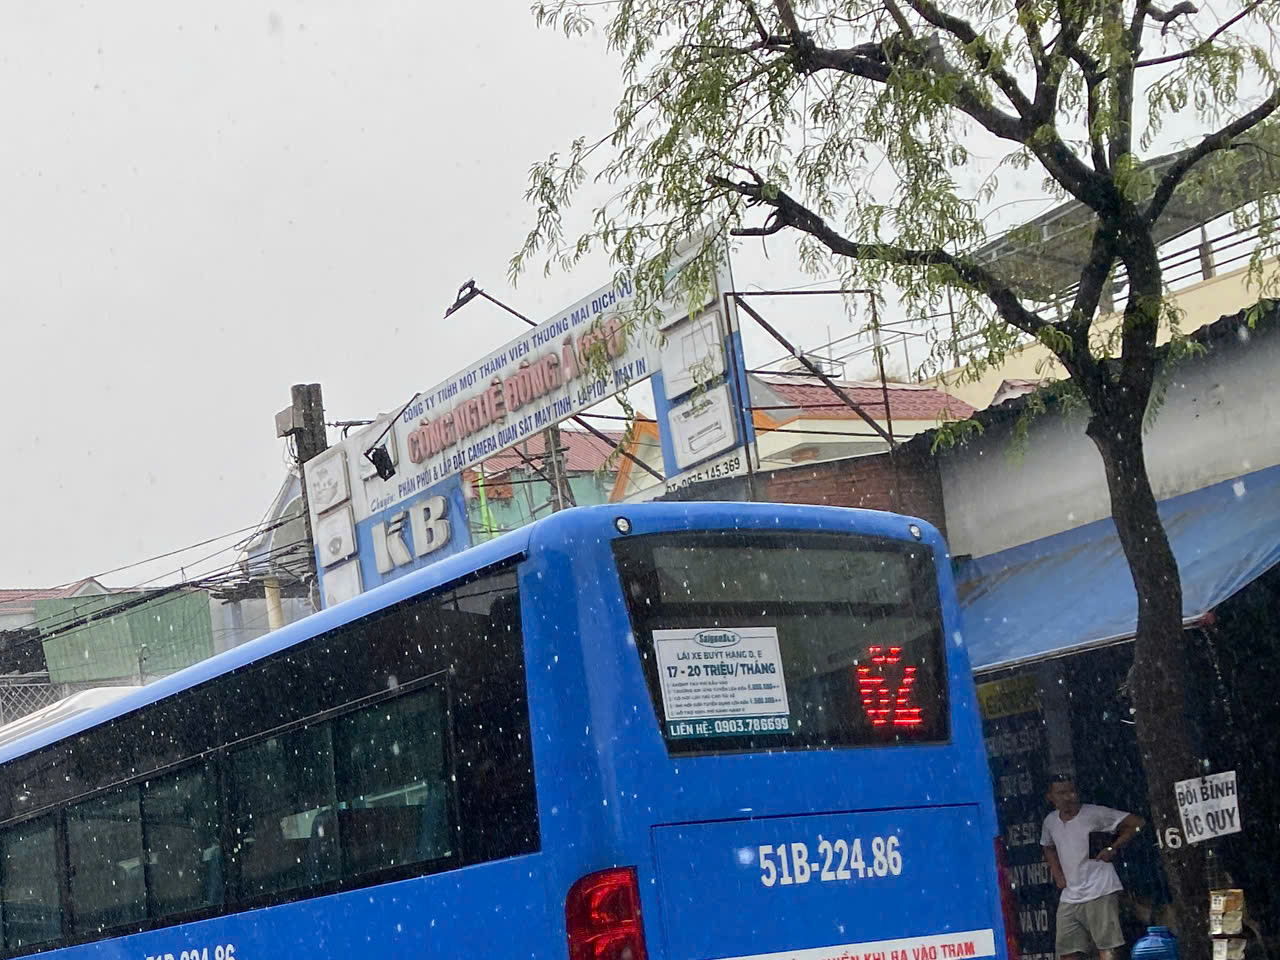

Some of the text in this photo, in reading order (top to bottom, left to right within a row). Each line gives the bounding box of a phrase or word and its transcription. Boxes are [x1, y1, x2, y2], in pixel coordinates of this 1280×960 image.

[403, 401, 423, 424] CÔNG
[425, 394, 436, 411] TY
[438, 381, 458, 404] TNHH
[459, 370, 477, 392] MỘT
[479, 354, 508, 382] THÀNH
[510, 339, 530, 366] VIÊN
[571, 302, 590, 330] MẠI
[433, 467, 440, 481] &
[468, 435, 498, 463] CAMERA
[498, 425, 518, 446] QUAN
[636, 357, 647, 375] IN
[692, 651, 703, 660] XE
[667, 666, 678, 678] 17
[687, 665, 701, 677] 20
[670, 721, 694, 736] LIÊN
[1200, 780, 1236, 803] BÌNH
[1205, 806, 1237, 836] QUY
[758, 835, 903, 888] 51B-224.86
